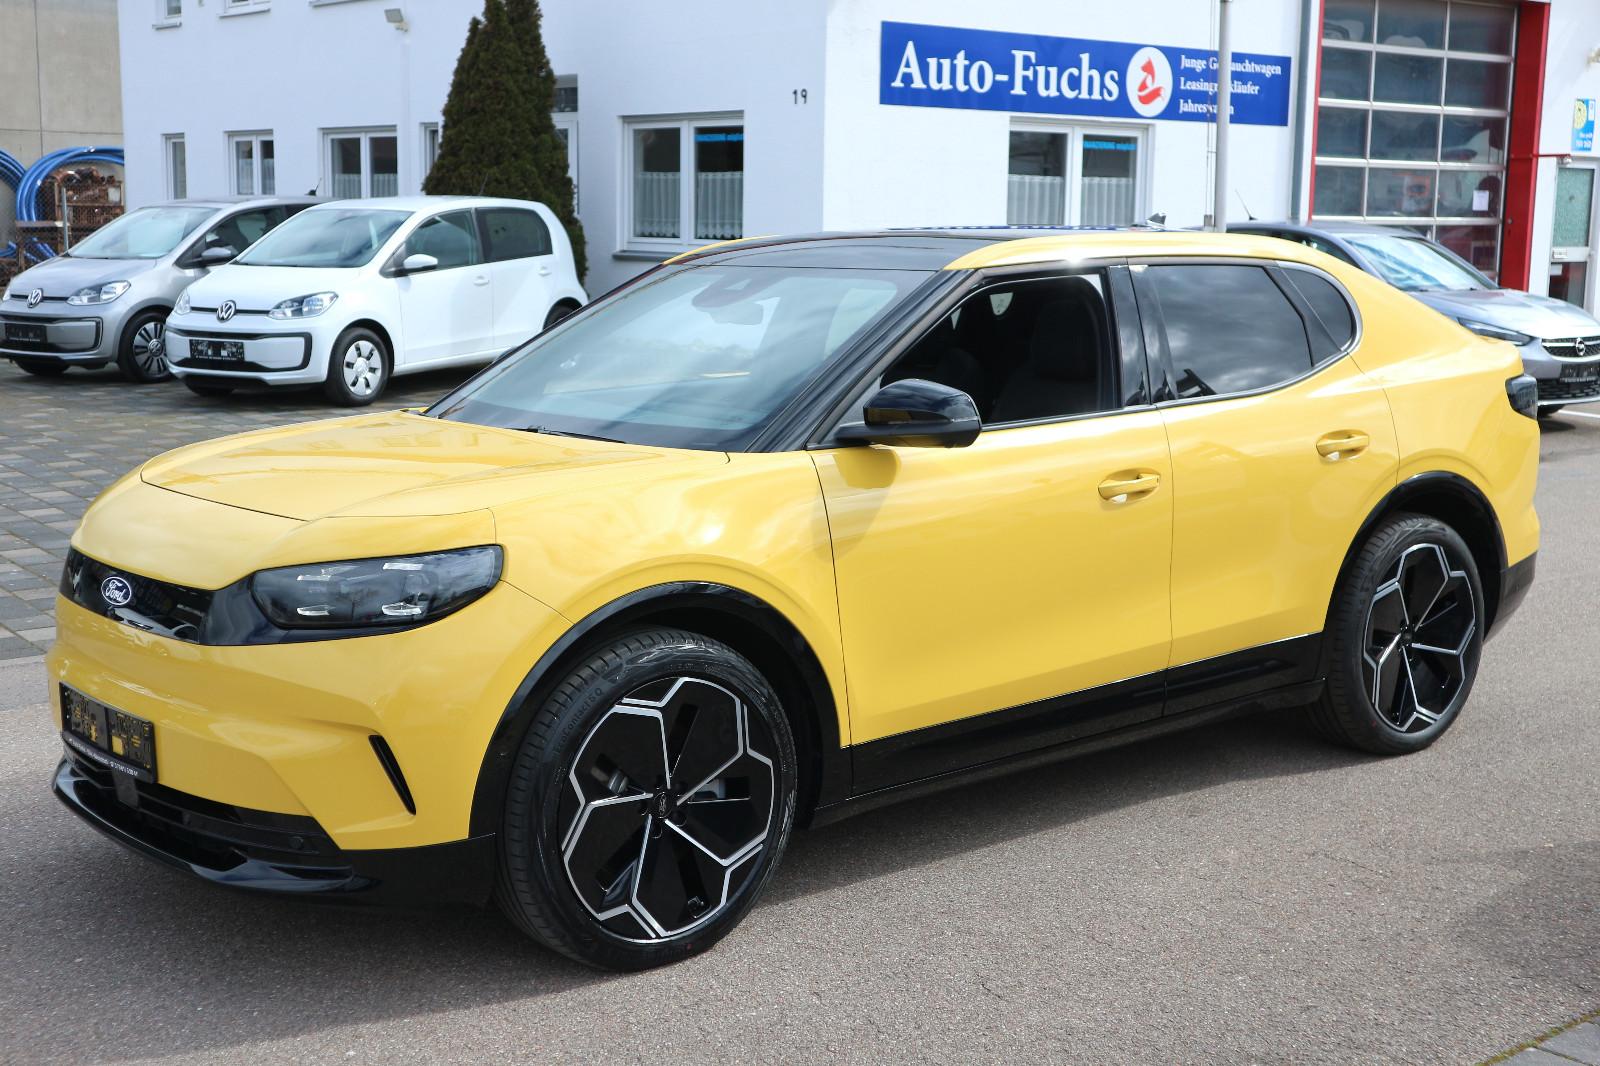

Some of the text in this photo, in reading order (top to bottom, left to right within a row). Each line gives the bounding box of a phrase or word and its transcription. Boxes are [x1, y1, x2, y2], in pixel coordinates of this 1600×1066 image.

[891, 40, 1119, 101] Auto-Fuchs
[1180, 55, 1207, 72] Junge
[792, 88, 808, 104] 19
[104, 578, 128, 603] Ford
